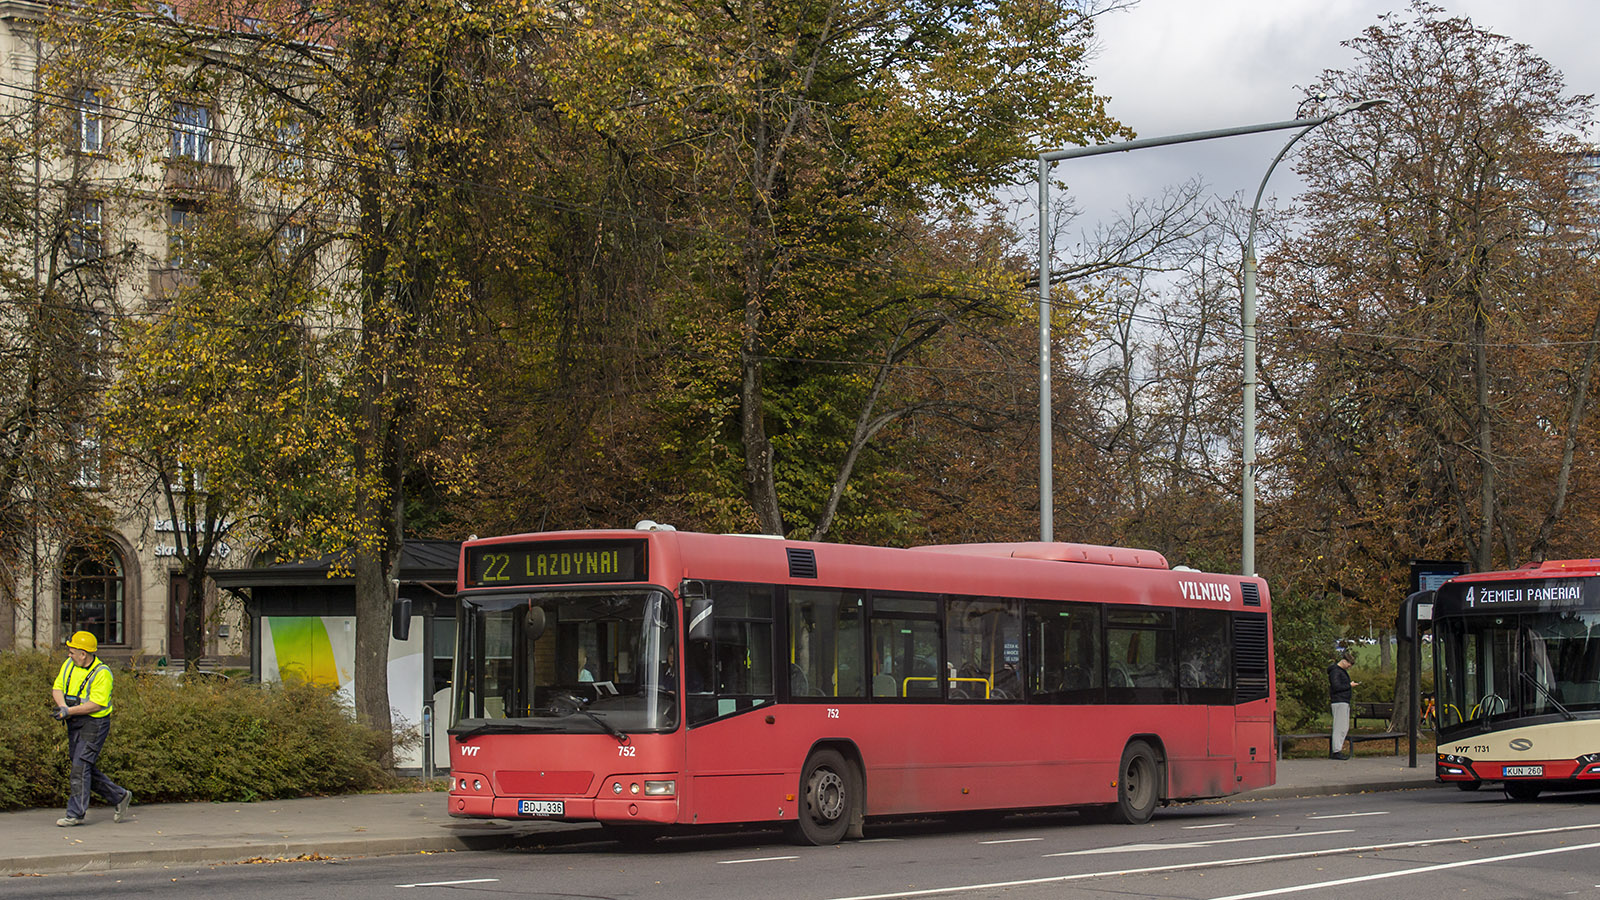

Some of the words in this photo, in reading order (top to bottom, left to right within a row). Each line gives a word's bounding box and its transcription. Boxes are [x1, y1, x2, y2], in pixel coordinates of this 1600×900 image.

[482, 554, 510, 581] 22
[526, 550, 618, 577] LAZDYNAI
[1178, 580, 1231, 602] VILNIUS
[1465, 586, 1475, 608] 4
[1480, 588, 1522, 603] ŽEMIEJI
[1527, 587, 1580, 601] PANERIAI
[827, 708, 840, 719] 752
[617, 746, 636, 757] 752
[1474, 745, 1490, 753] 1731
[1527, 767, 1542, 775] 260
